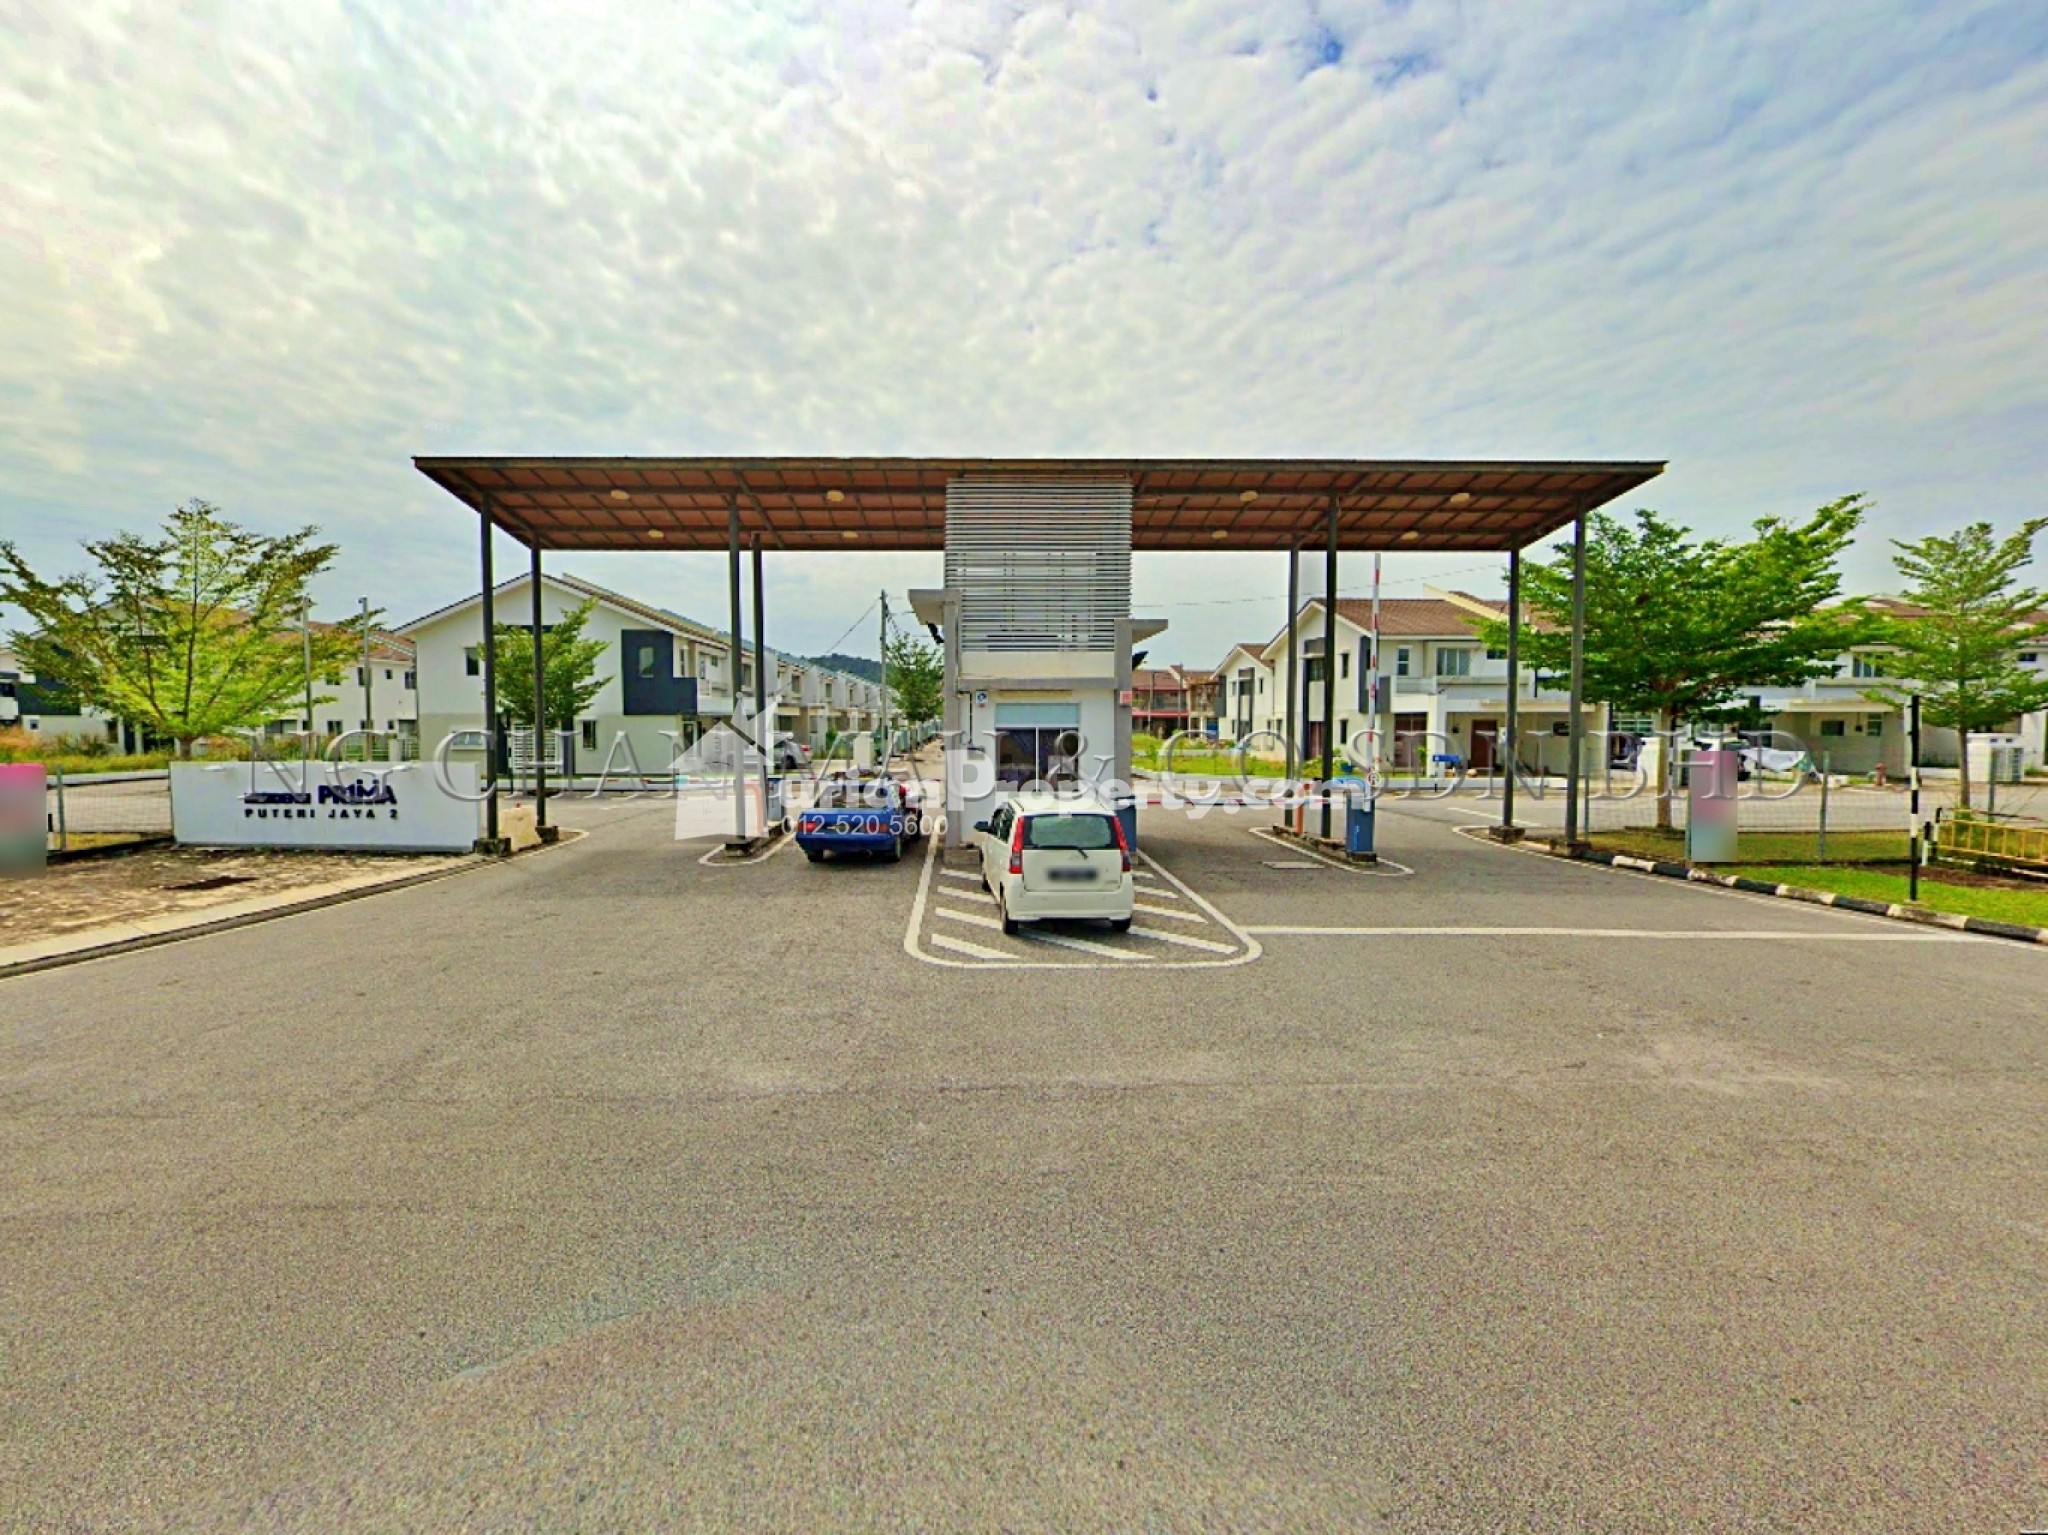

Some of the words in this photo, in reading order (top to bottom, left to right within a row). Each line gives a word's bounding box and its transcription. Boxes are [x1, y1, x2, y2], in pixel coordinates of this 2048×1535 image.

[244, 808, 316, 819] PUTERI
[327, 808, 376, 819] JAYA
[389, 808, 399, 819] 2
